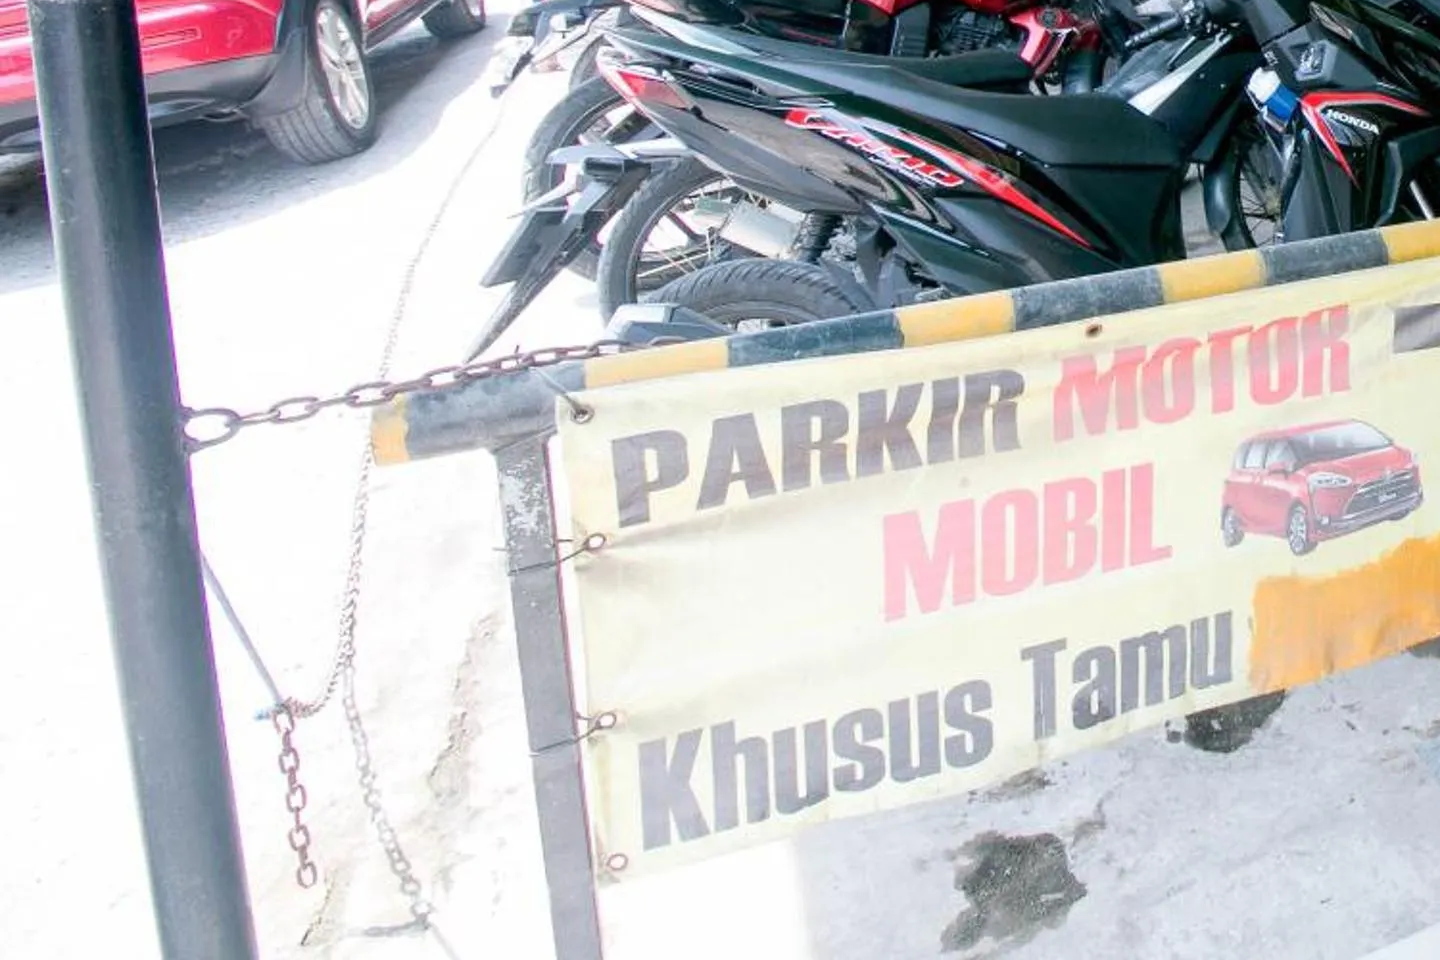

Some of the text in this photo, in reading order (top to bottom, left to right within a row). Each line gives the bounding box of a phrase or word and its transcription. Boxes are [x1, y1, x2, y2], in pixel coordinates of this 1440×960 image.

[1326, 108, 1381, 136] HONDA
[611, 303, 1352, 528] PARKIR MOTOR
[883, 462, 1173, 622] MOBIL
[638, 610, 1233, 851] Khusus Tamu
